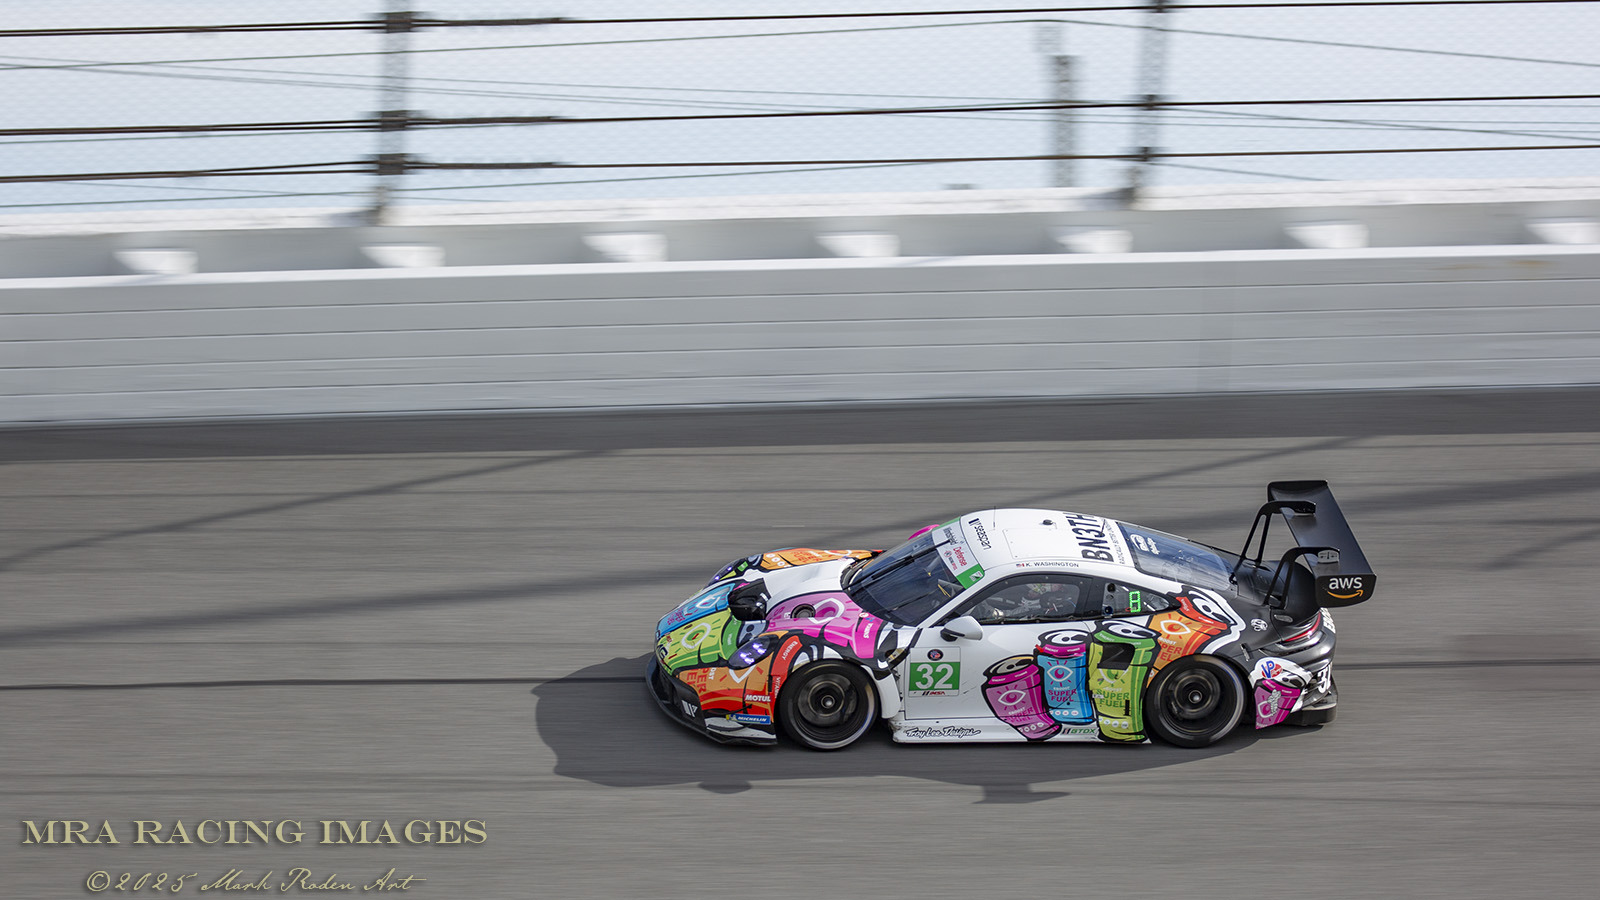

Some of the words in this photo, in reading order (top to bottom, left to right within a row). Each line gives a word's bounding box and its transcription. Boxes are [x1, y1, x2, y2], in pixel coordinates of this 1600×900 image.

[974, 524, 992, 550] seaspan
[1063, 511, 1115, 563] BN3TH
[953, 546, 968, 567] Defense
[1328, 576, 1363, 590] aws
[915, 663, 954, 690] 32
[1260, 660, 1276, 679] VP
[745, 694, 772, 703] MOTUL
[1048, 688, 1077, 697] SUPER
[1096, 688, 1130, 700] SUPER
[1099, 699, 1126, 708] FUEL
[738, 715, 767, 723] MICHELIN
